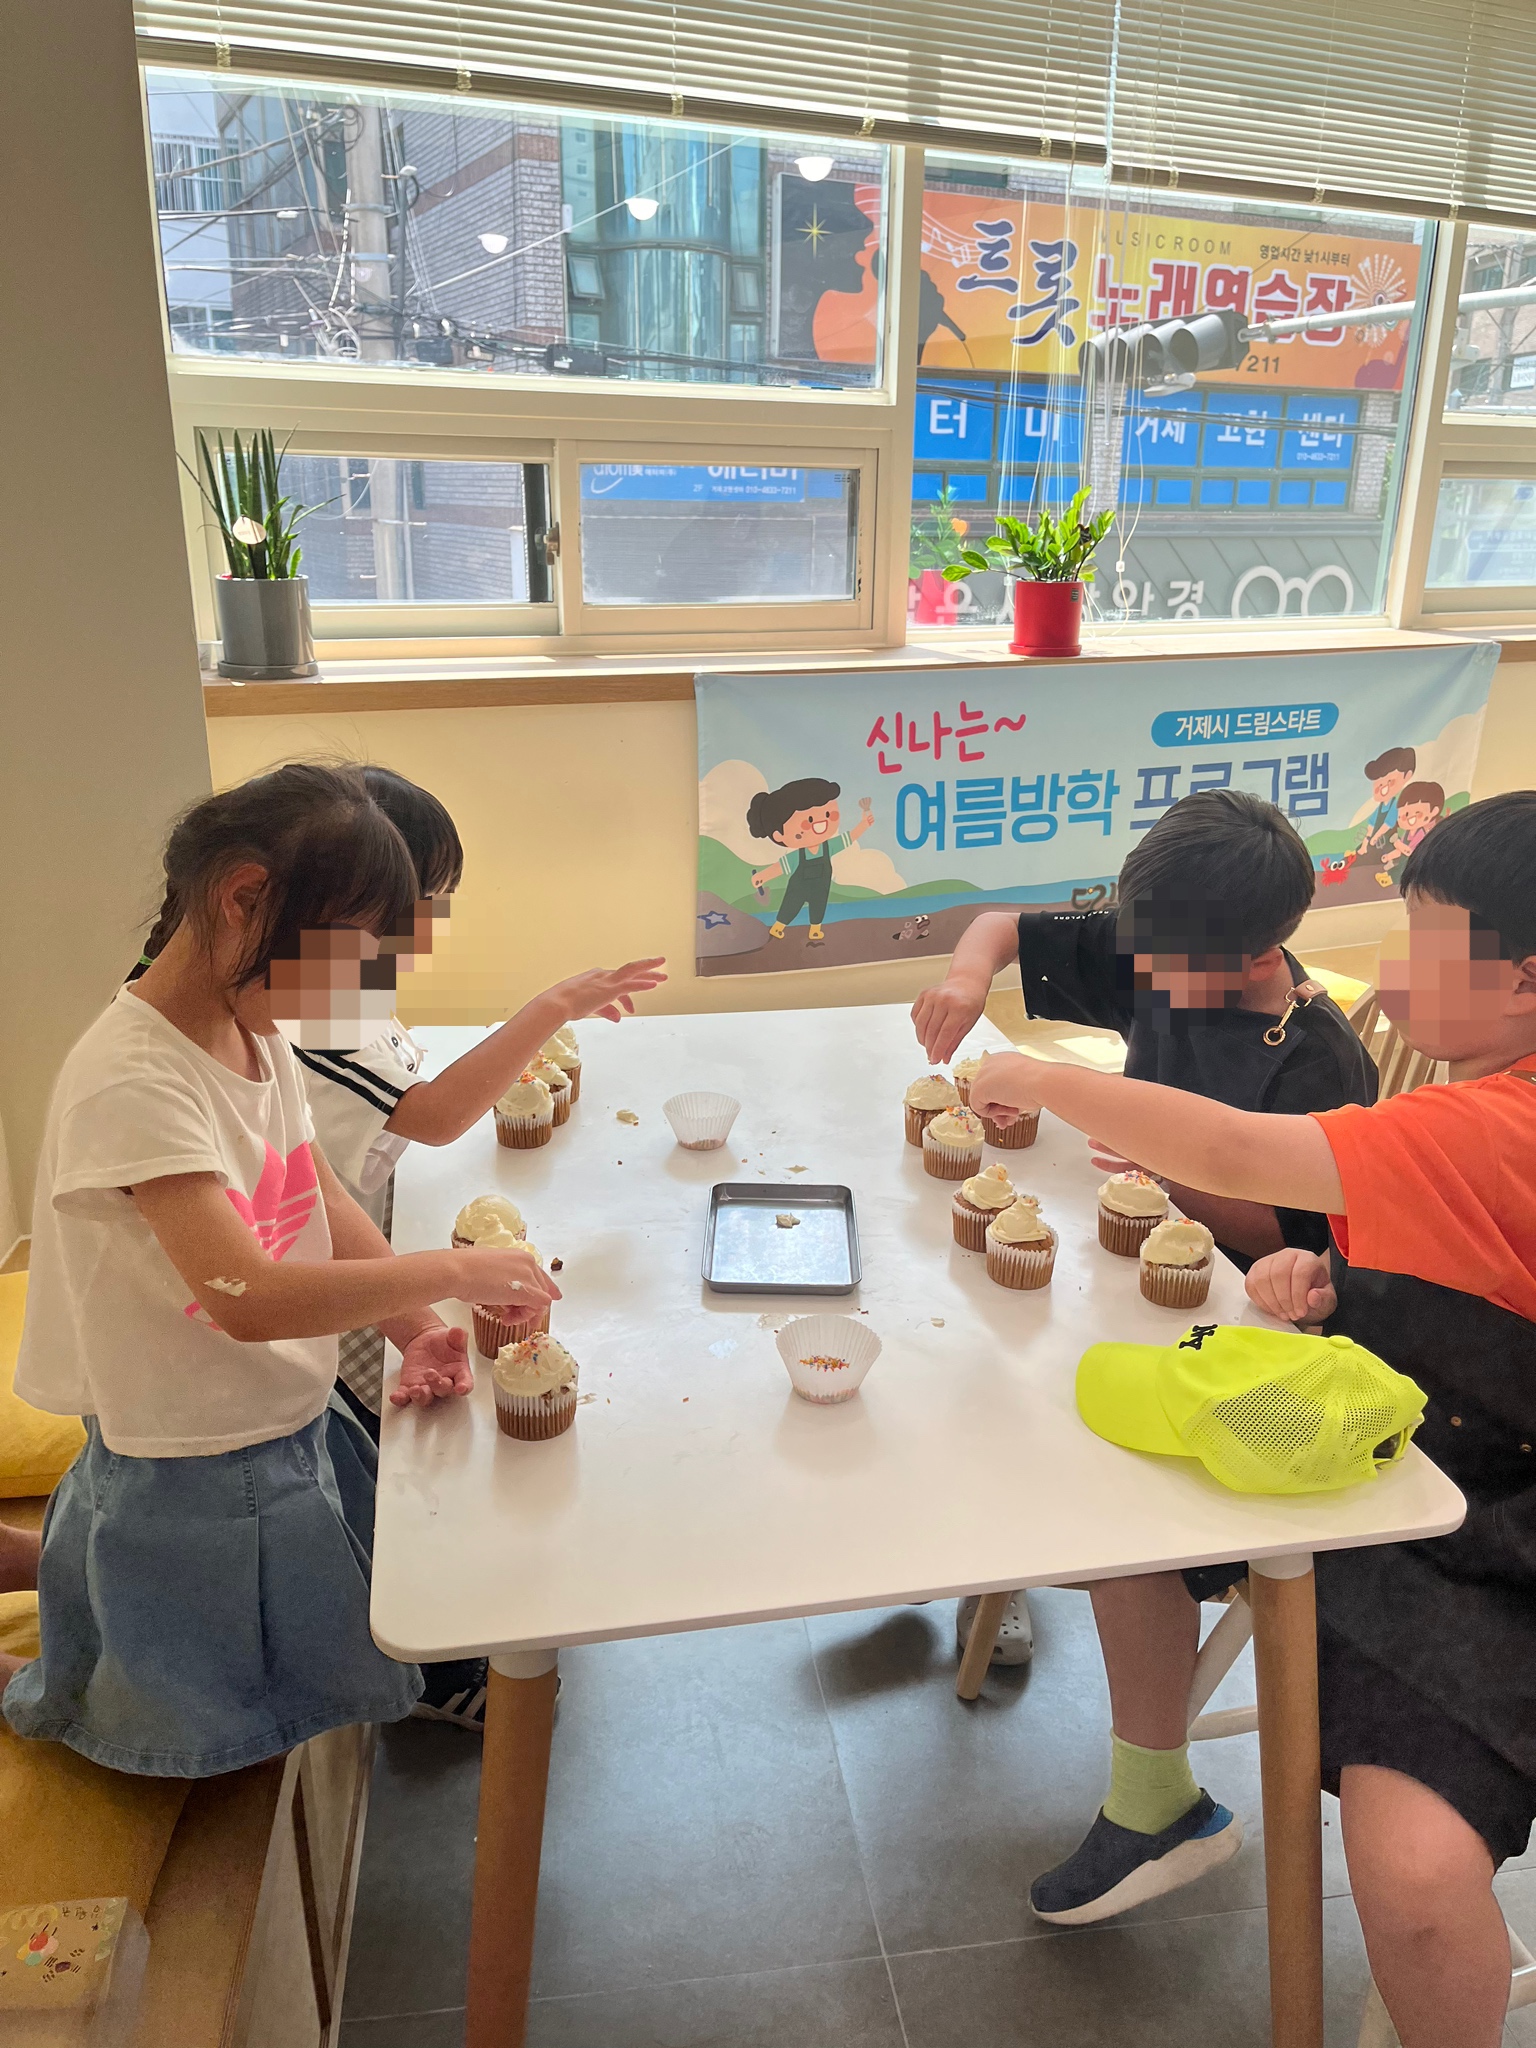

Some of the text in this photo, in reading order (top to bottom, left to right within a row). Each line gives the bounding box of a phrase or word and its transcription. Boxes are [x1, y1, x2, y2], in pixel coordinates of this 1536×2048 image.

[1260, 244, 1351, 267] 영업시간 낮1시부터
[866, 700, 1026, 774] 신나는~
[1175, 708, 1322, 741] 거제시 드림스타트
[896, 768, 1121, 851] 여름방학
